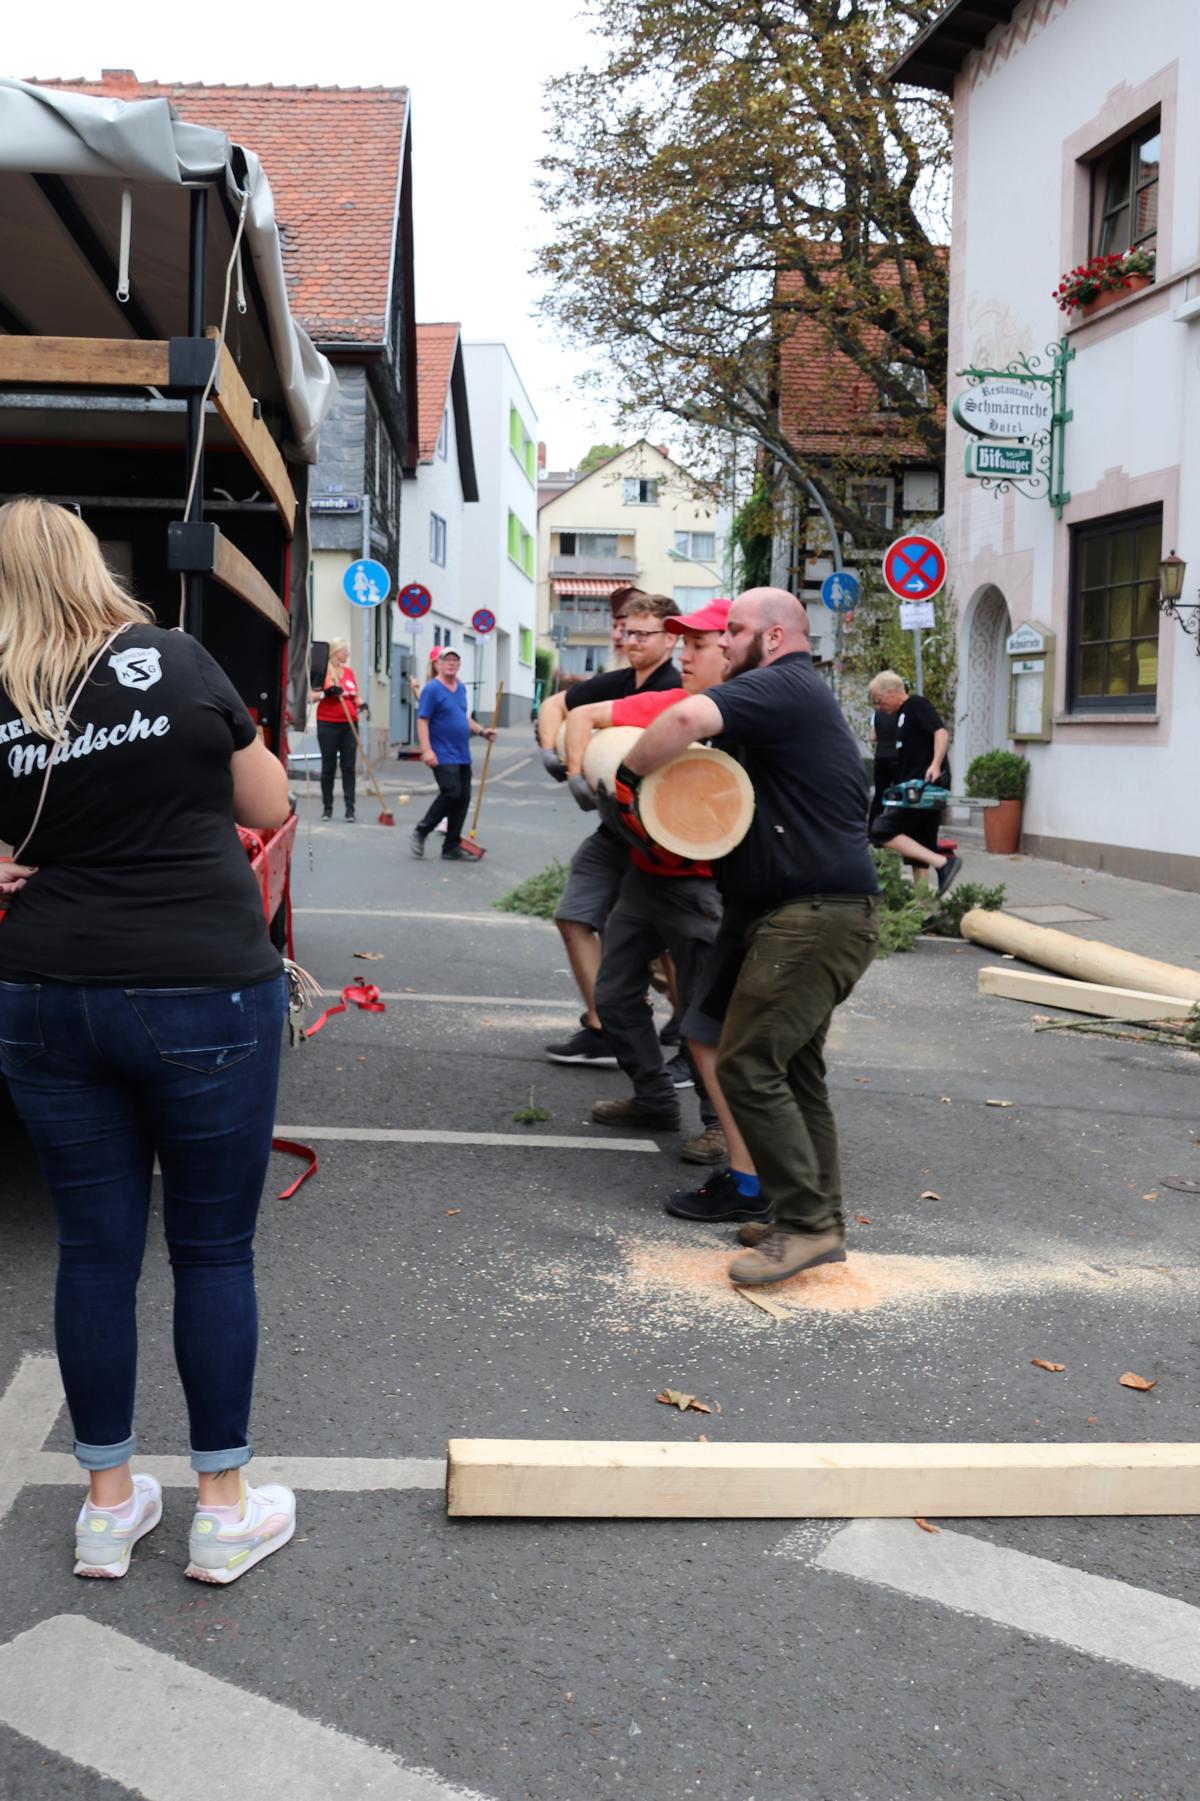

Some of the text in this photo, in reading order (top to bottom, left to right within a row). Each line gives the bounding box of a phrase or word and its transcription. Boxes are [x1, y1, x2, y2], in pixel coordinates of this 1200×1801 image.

[982, 385, 1034, 400] Restaurant
[989, 418, 1022, 432] Hotel
[978, 448, 1031, 473] Bitburger
